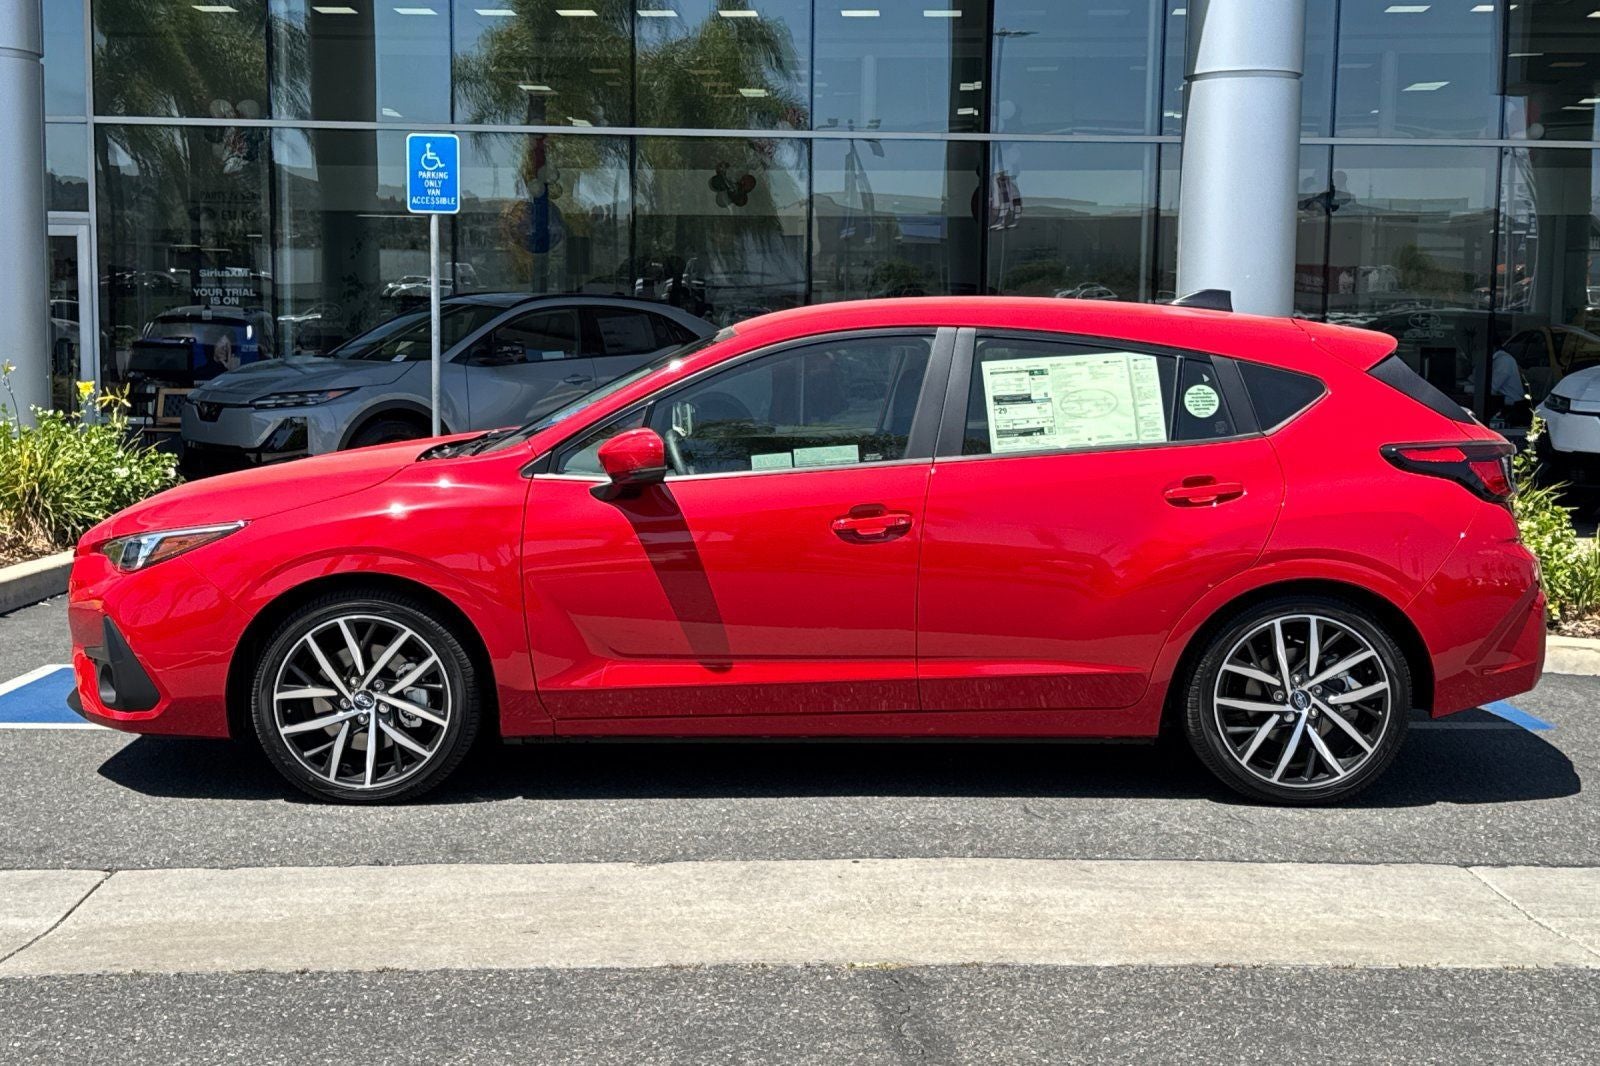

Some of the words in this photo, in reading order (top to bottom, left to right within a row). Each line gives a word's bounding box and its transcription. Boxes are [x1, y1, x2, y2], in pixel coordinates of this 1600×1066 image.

[418, 171, 449, 179] PARKING
[424, 180, 443, 188] ONLY
[411, 196, 456, 205] ACCESSIBLE
[199, 268, 249, 277] SiriusXM
[193, 288, 223, 297] YOUR
[225, 288, 257, 297] TRIAL
[210, 297, 221, 305] IS
[223, 297, 239, 305] ON
[998, 407, 1008, 415] 29
